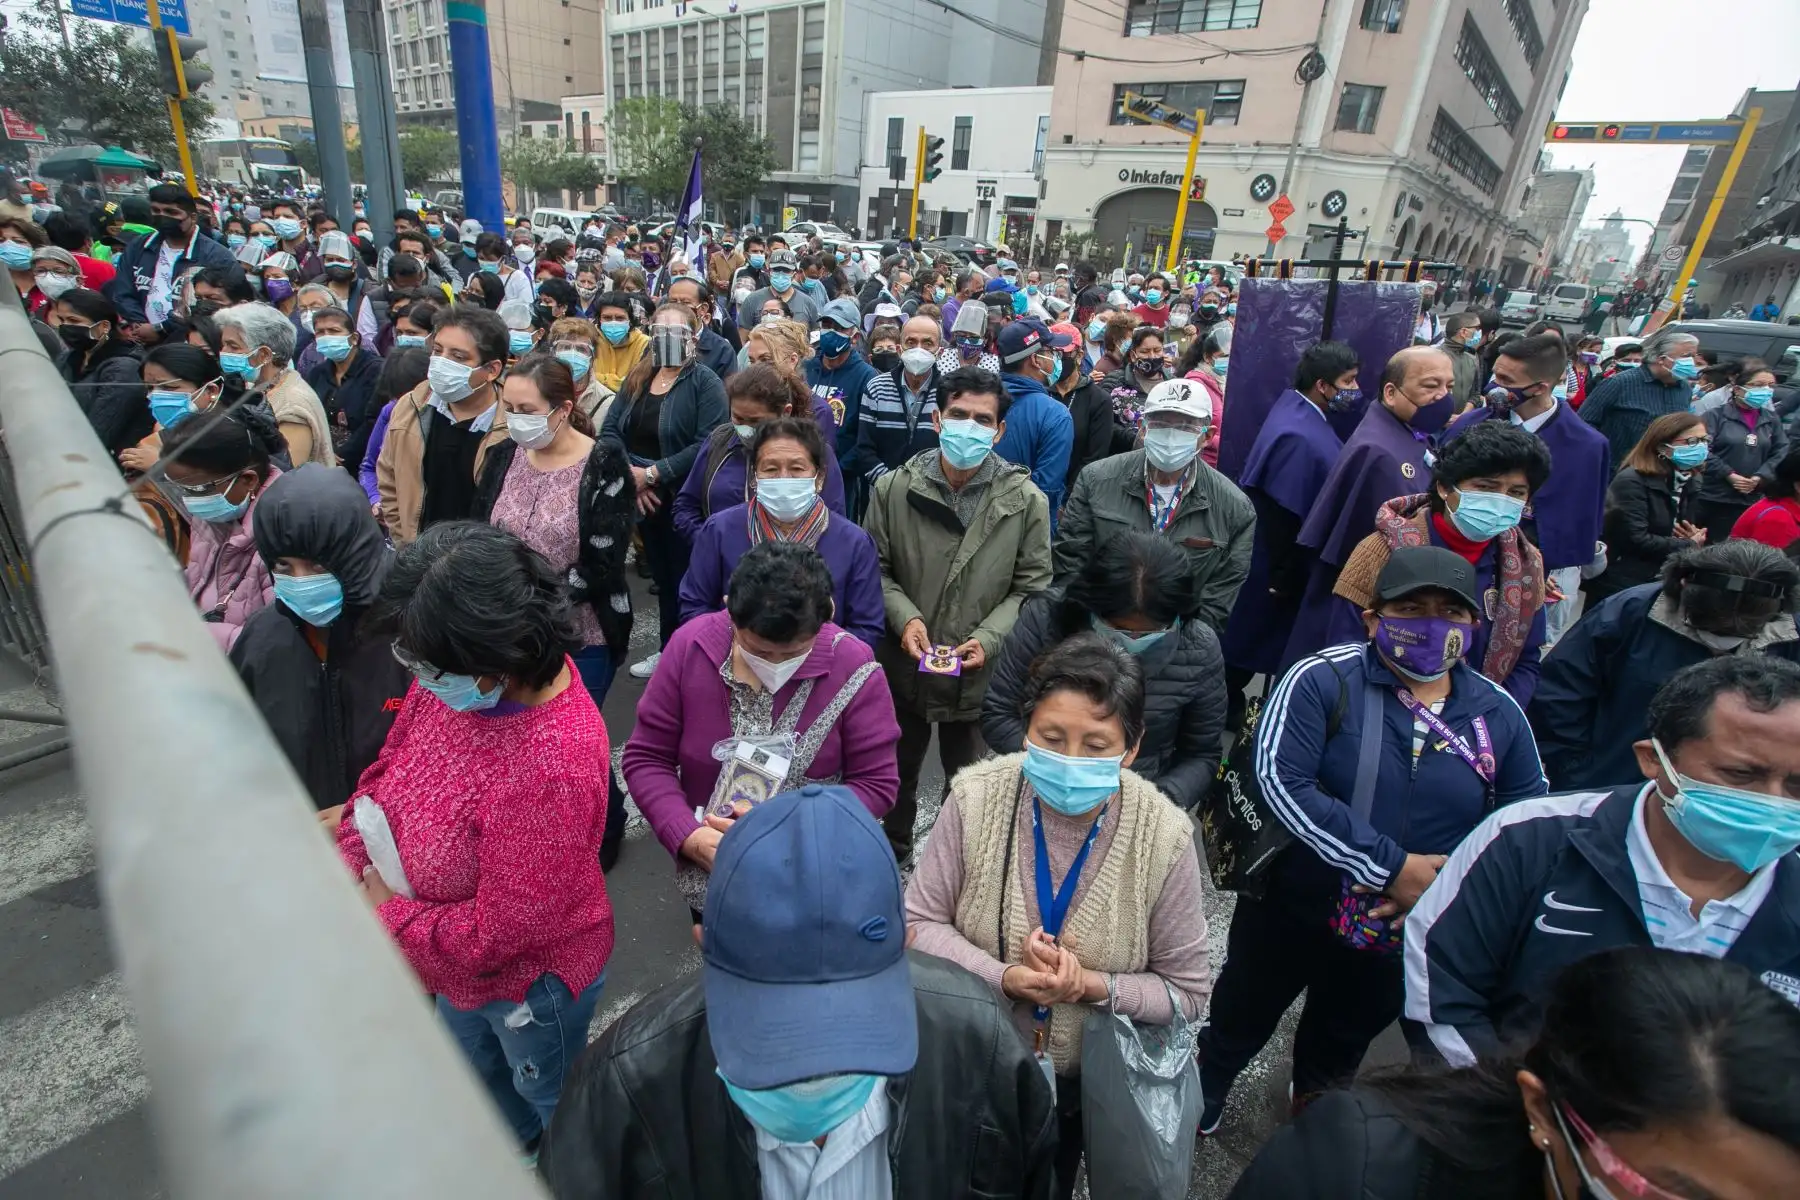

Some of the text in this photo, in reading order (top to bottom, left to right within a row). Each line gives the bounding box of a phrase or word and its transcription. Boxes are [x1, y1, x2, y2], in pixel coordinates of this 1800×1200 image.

[115, 0, 183, 18] HUANCELICA
[1130, 169, 1202, 185] Inkafar
[976, 185, 997, 198] TEA
[1418, 707, 1446, 731] MILAGROS
[1443, 728, 1455, 740] LOS
[1458, 743, 1477, 761] SEÑOR
[1763, 971, 1800, 988] ALIAN
